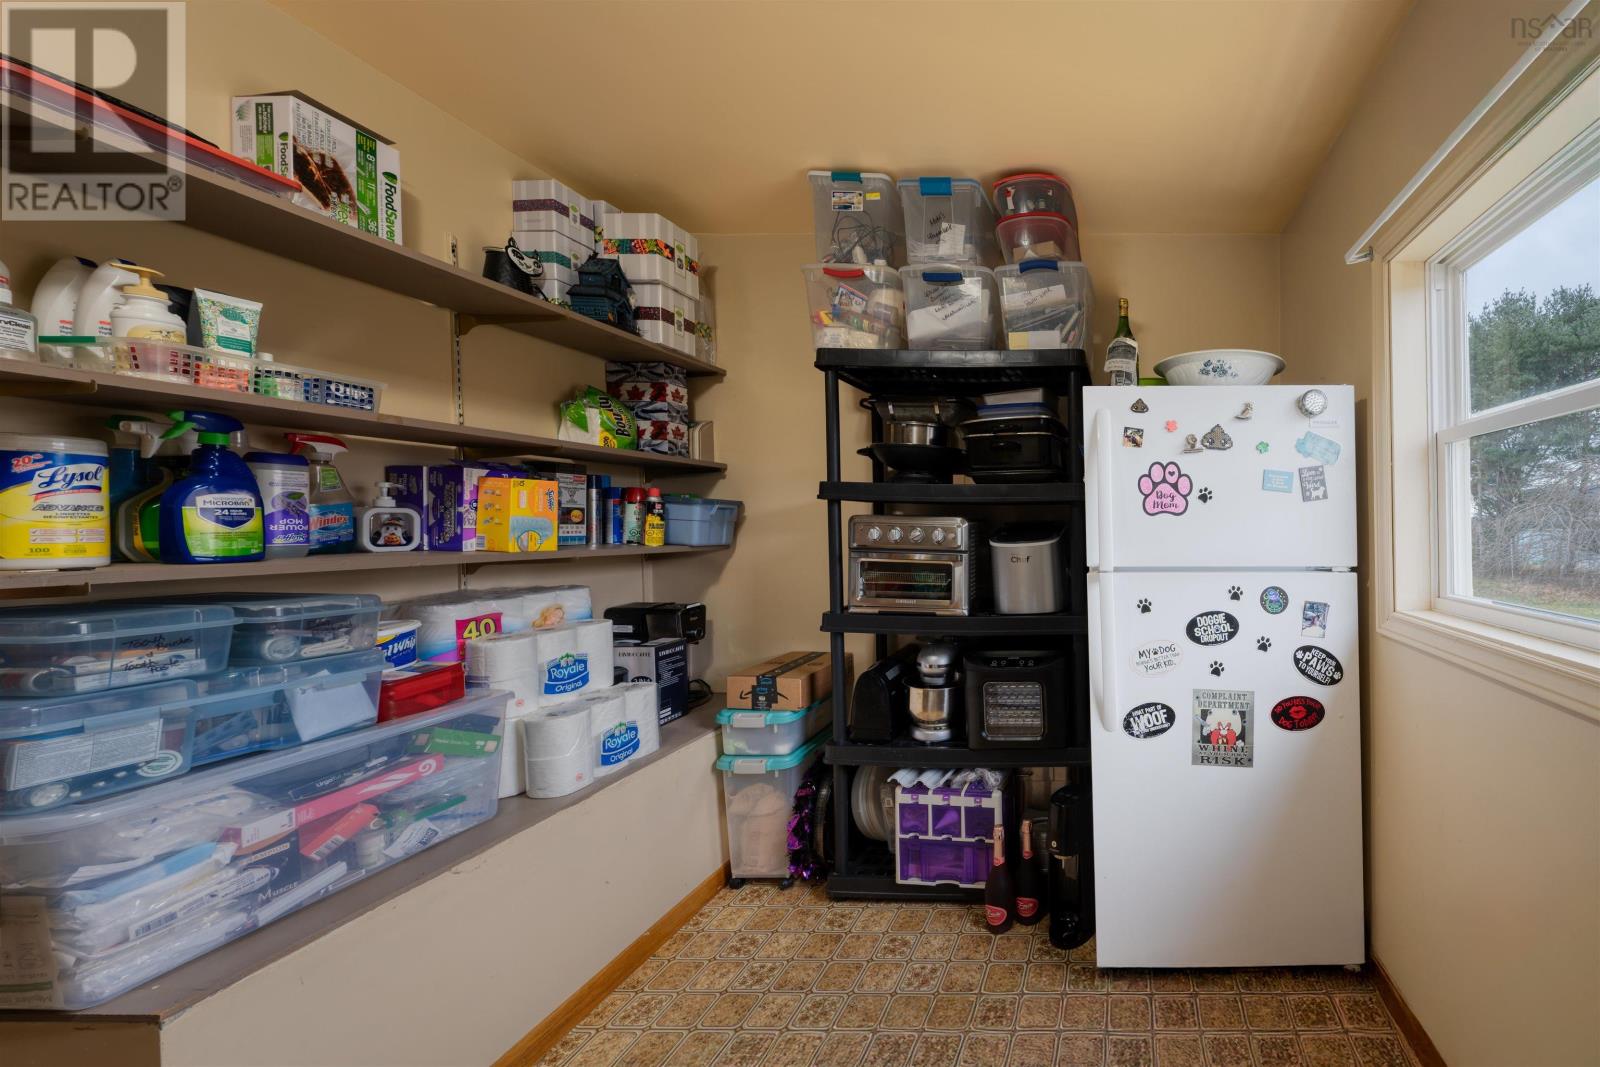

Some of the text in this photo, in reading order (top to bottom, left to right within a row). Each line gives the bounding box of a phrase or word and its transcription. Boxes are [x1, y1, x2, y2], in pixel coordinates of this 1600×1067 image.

[385, 182, 398, 242] FoodSaver
[600, 394, 632, 438] Bouty
[38, 466, 102, 489] Lysol
[1156, 490, 1176, 502] Dog
[1152, 501, 1179, 509] Mom
[1196, 613, 1227, 627] DOGGIE
[463, 618, 496, 641] 40
[1194, 622, 1234, 637] SCHOOL
[1200, 632, 1229, 643] DROPOUT
[1138, 643, 1176, 659] MY DOG
[1311, 648, 1326, 659] KEEP
[550, 663, 585, 679] Royale
[1144, 661, 1162, 671] YOUR
[1299, 660, 1307, 669] TO
[1302, 651, 1336, 677] PAWS
[555, 680, 583, 693] Original
[1201, 692, 1248, 701] COMPLAINT
[1198, 700, 1250, 709] DEPARTMENT
[1130, 709, 1168, 732] WOOF
[604, 730, 636, 750] Royale
[610, 748, 633, 762] Original
[1200, 755, 1245, 765] RISK
